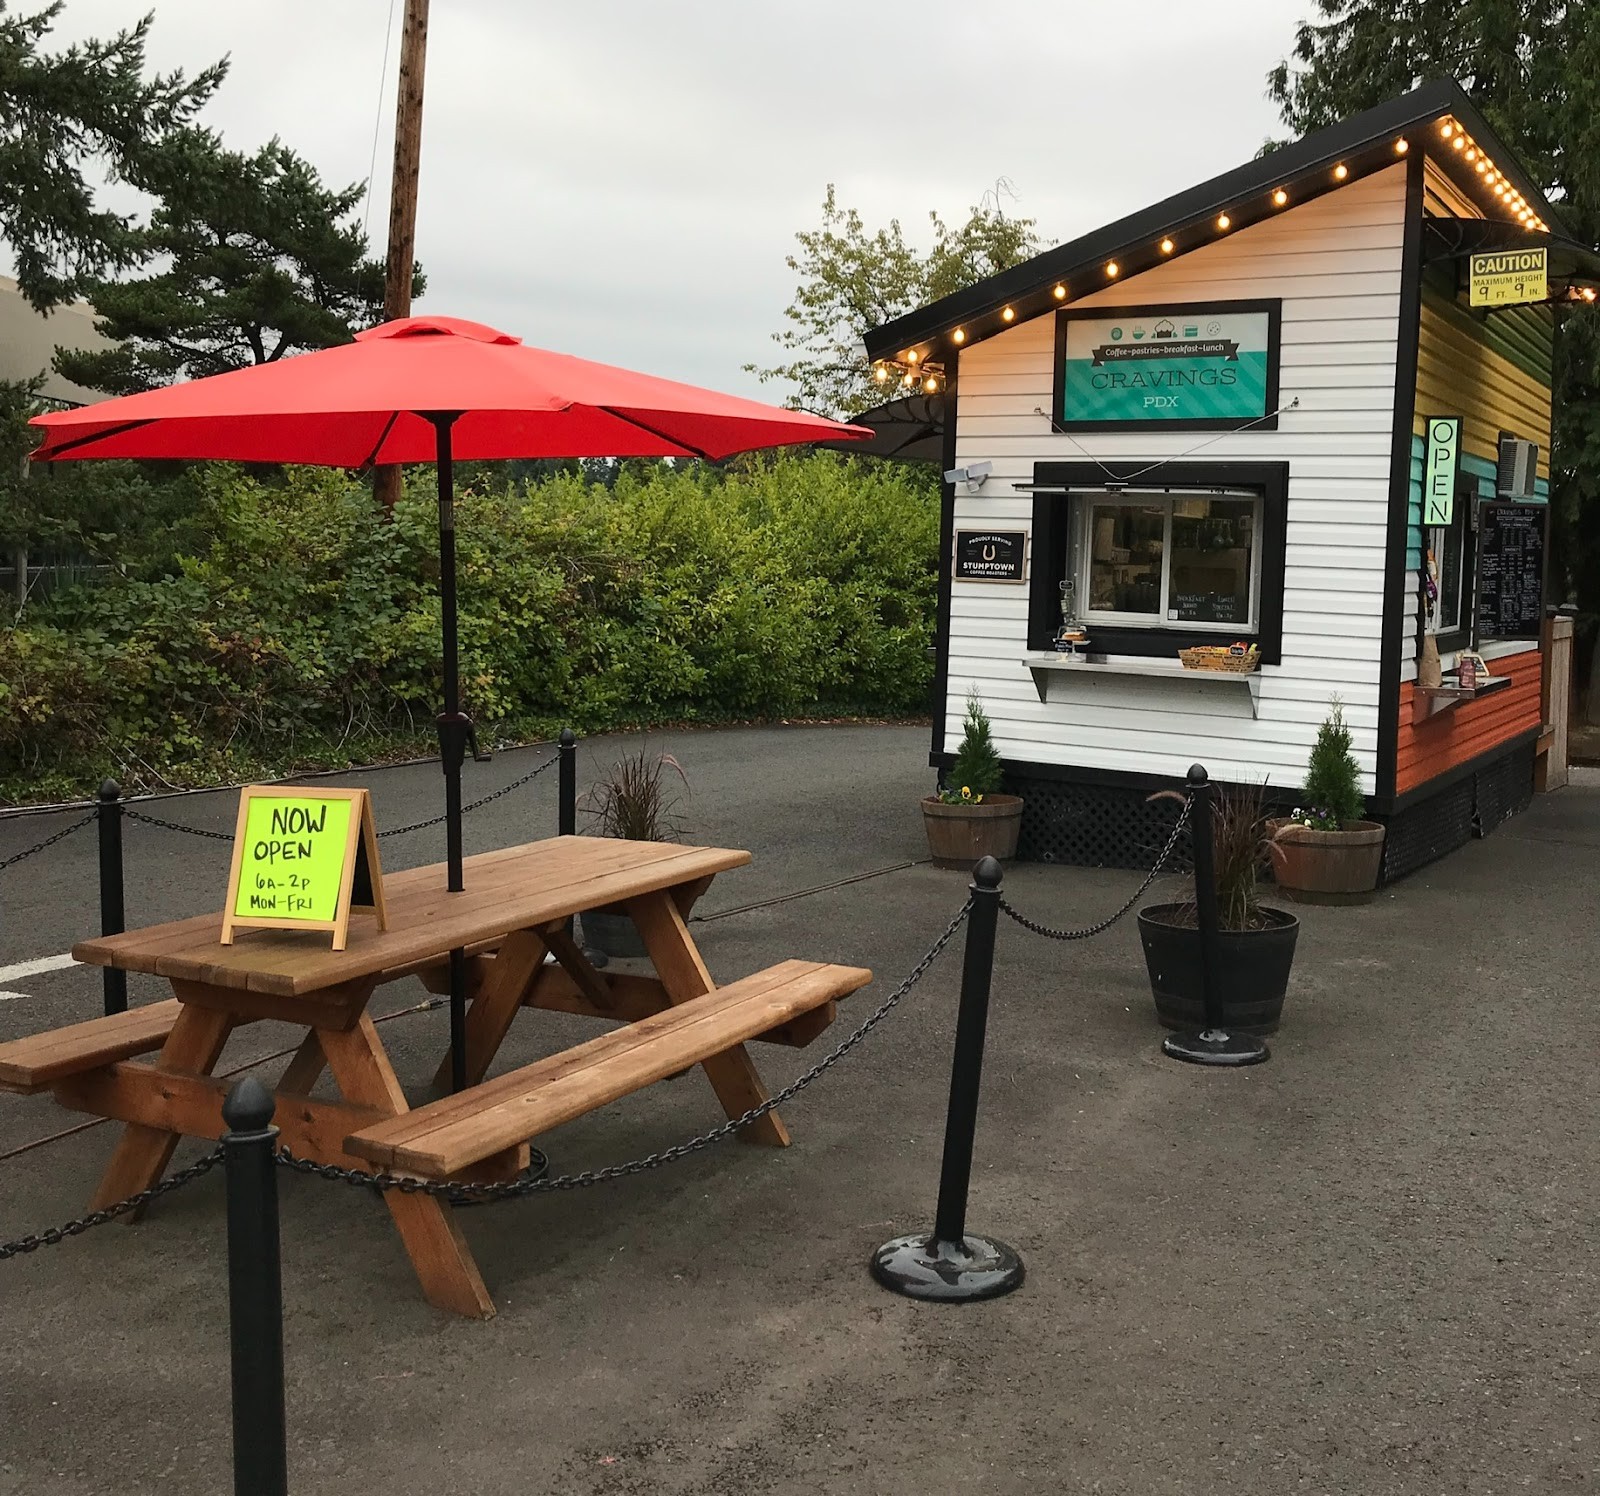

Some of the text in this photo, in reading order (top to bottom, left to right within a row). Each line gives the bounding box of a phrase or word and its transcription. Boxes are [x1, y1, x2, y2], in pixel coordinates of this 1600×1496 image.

[1474, 253, 1542, 274] CAUTION
[1473, 274, 1543, 286] MAXIMUM HEIGHT
[1479, 283, 1541, 301] 9 FT. 9 IN.
[1091, 367, 1237, 390] CRAVINGS
[1143, 395, 1179, 408] PDX
[1430, 421, 1453, 523] OPEN
[968, 535, 1012, 546] PROUDLY SERVING
[963, 561, 1015, 571] STUMPTOWN
[271, 804, 327, 836] NOW
[253, 839, 313, 865] OPEN
[250, 894, 312, 912] MON-FRI
